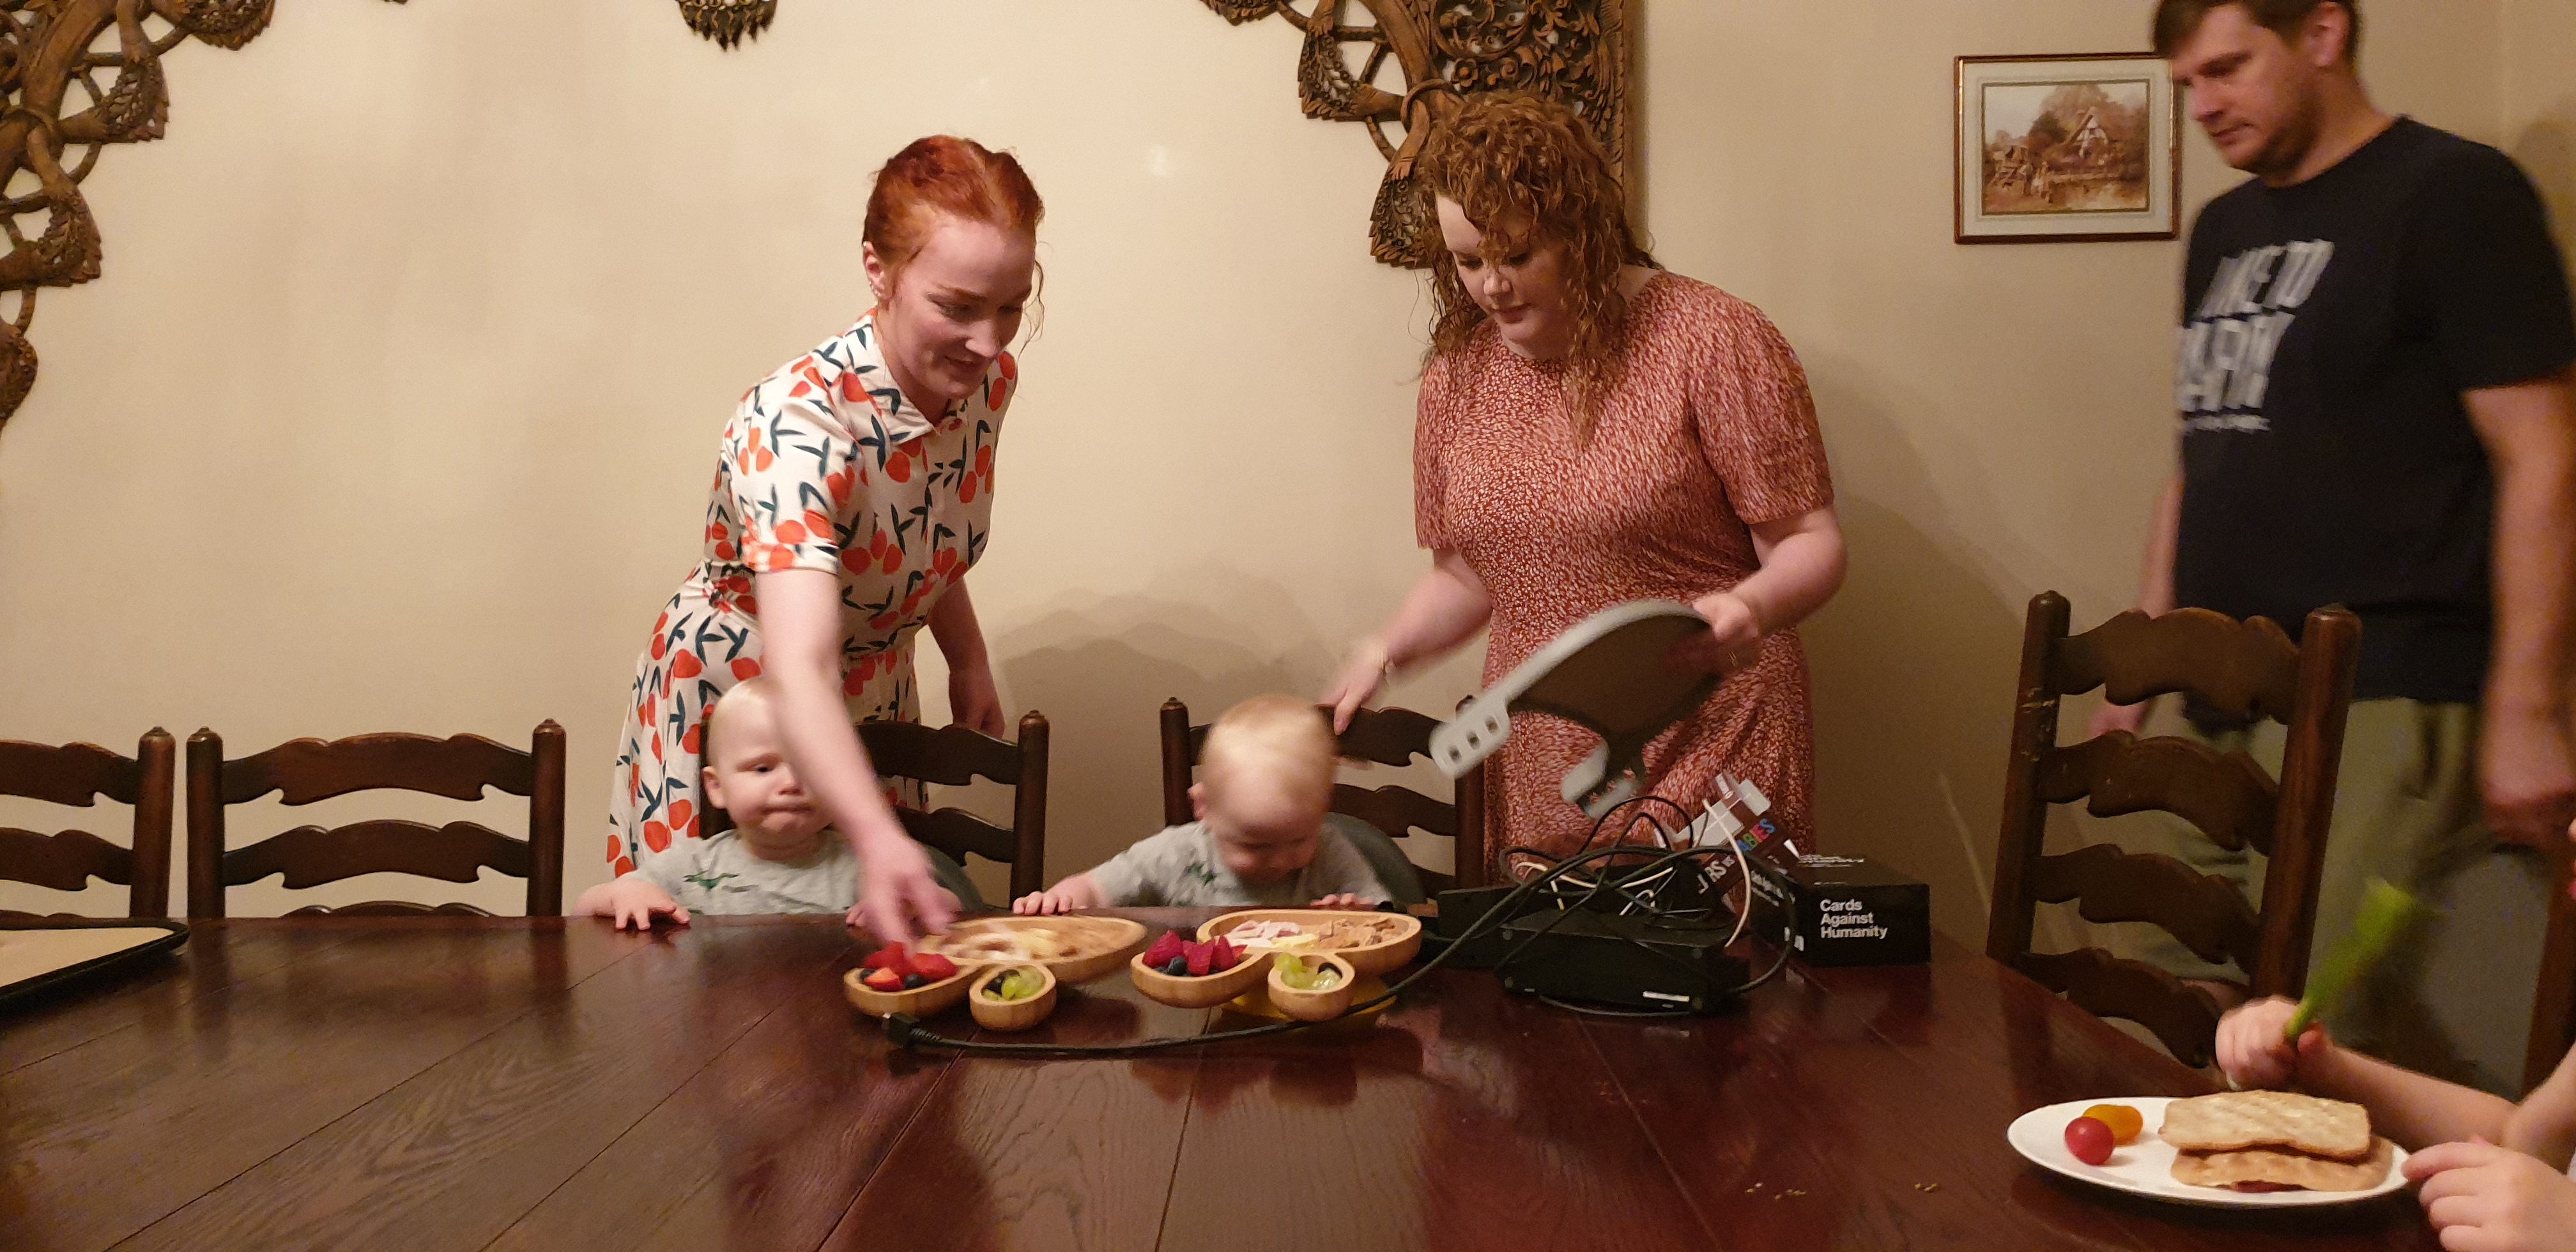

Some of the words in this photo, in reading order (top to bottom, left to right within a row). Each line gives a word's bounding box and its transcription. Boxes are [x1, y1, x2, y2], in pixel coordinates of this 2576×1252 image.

[1820, 899, 1863, 912] Cards
[1821, 912, 1874, 927] Against
[1821, 925, 1889, 940] Humanity
